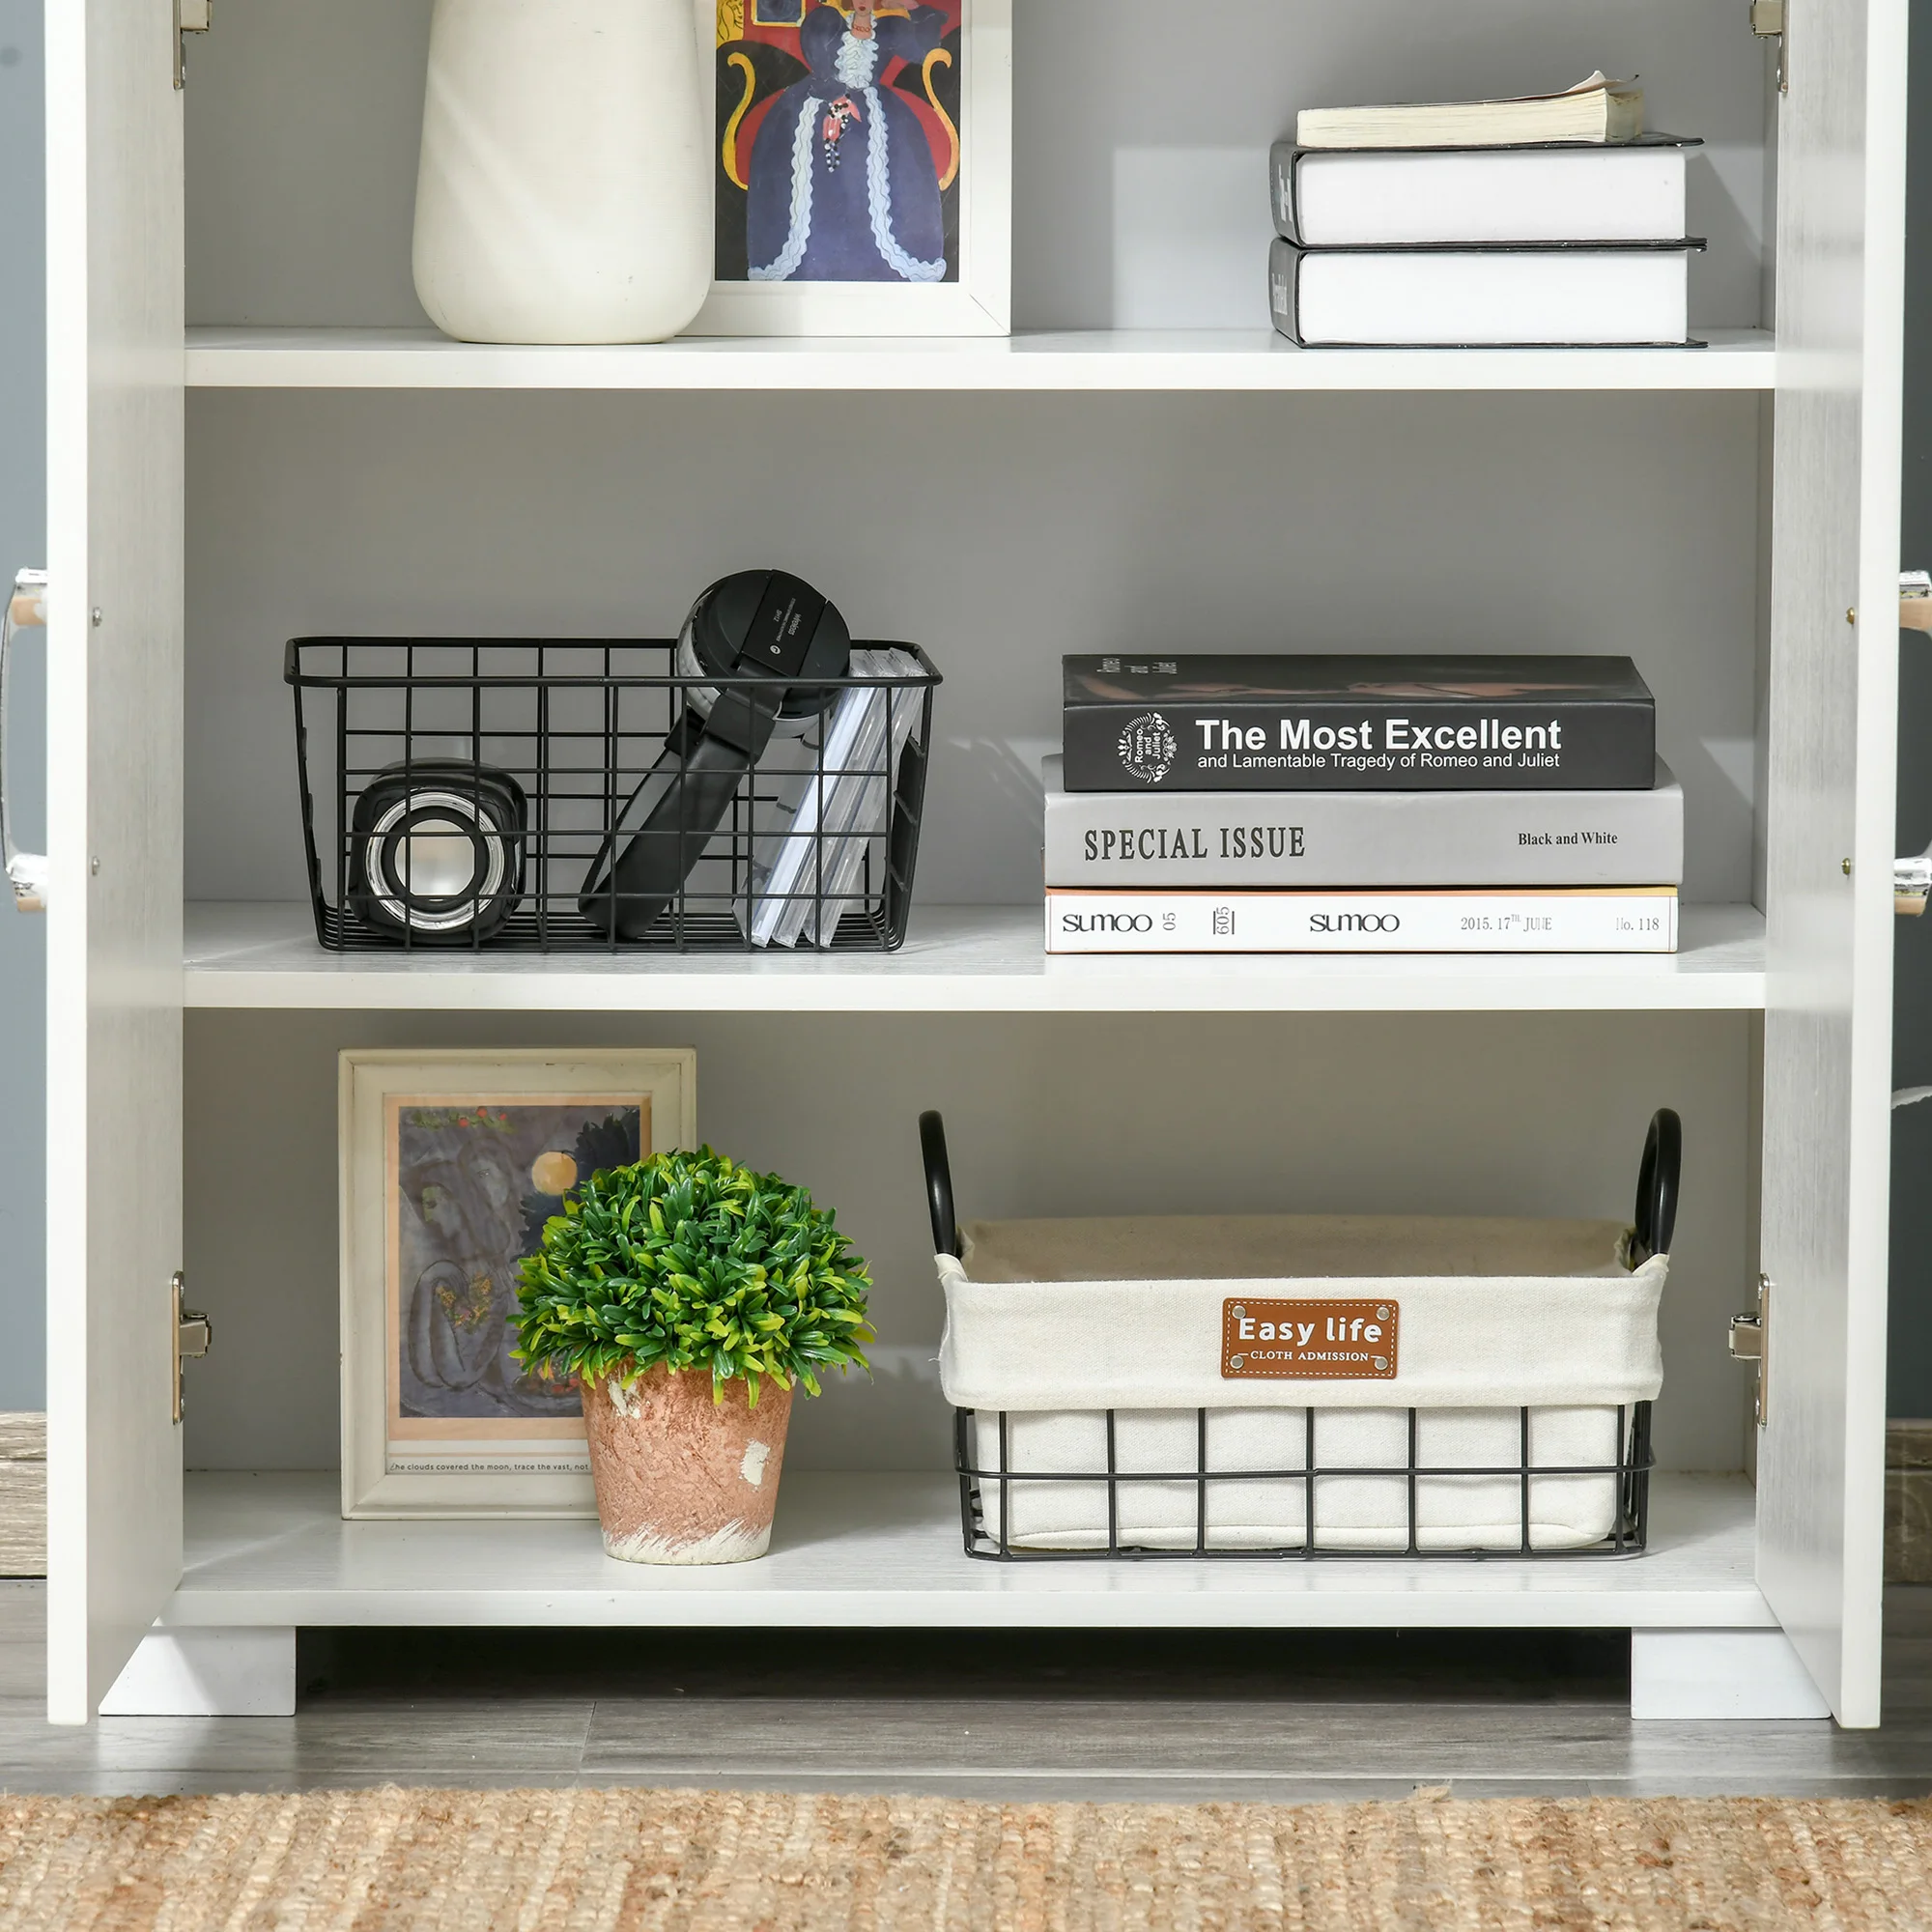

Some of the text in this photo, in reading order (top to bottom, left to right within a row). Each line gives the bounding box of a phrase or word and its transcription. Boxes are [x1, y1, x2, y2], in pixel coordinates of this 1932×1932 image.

[1195, 719, 1562, 751] The Most Excellent
[1134, 728, 1144, 763] Romeo
[1144, 737, 1152, 755] and
[1152, 731, 1161, 759] Juliet
[1197, 753, 1561, 772] and Lamentable Tragedy of Romeo and Juliet
[1084, 826, 1306, 862] SPECIAL ISSUE
[1518, 832, 1618, 845] Black and White
[1215, 906, 1231, 936] 605
[1460, 917, 1493, 931] 2015.
[1638, 917, 1660, 931] 118
[1238, 1318, 1382, 1347] Easy life
[1250, 1350, 1370, 1362] CLOTH ADMISSION
[407, 1463, 435, 1471] clouds
[436, 1463, 469, 1471] covered
[471, 1463, 485, 1471] the
[487, 1463, 512, 1472] moon,
[553, 1463, 573, 1472] vast,
